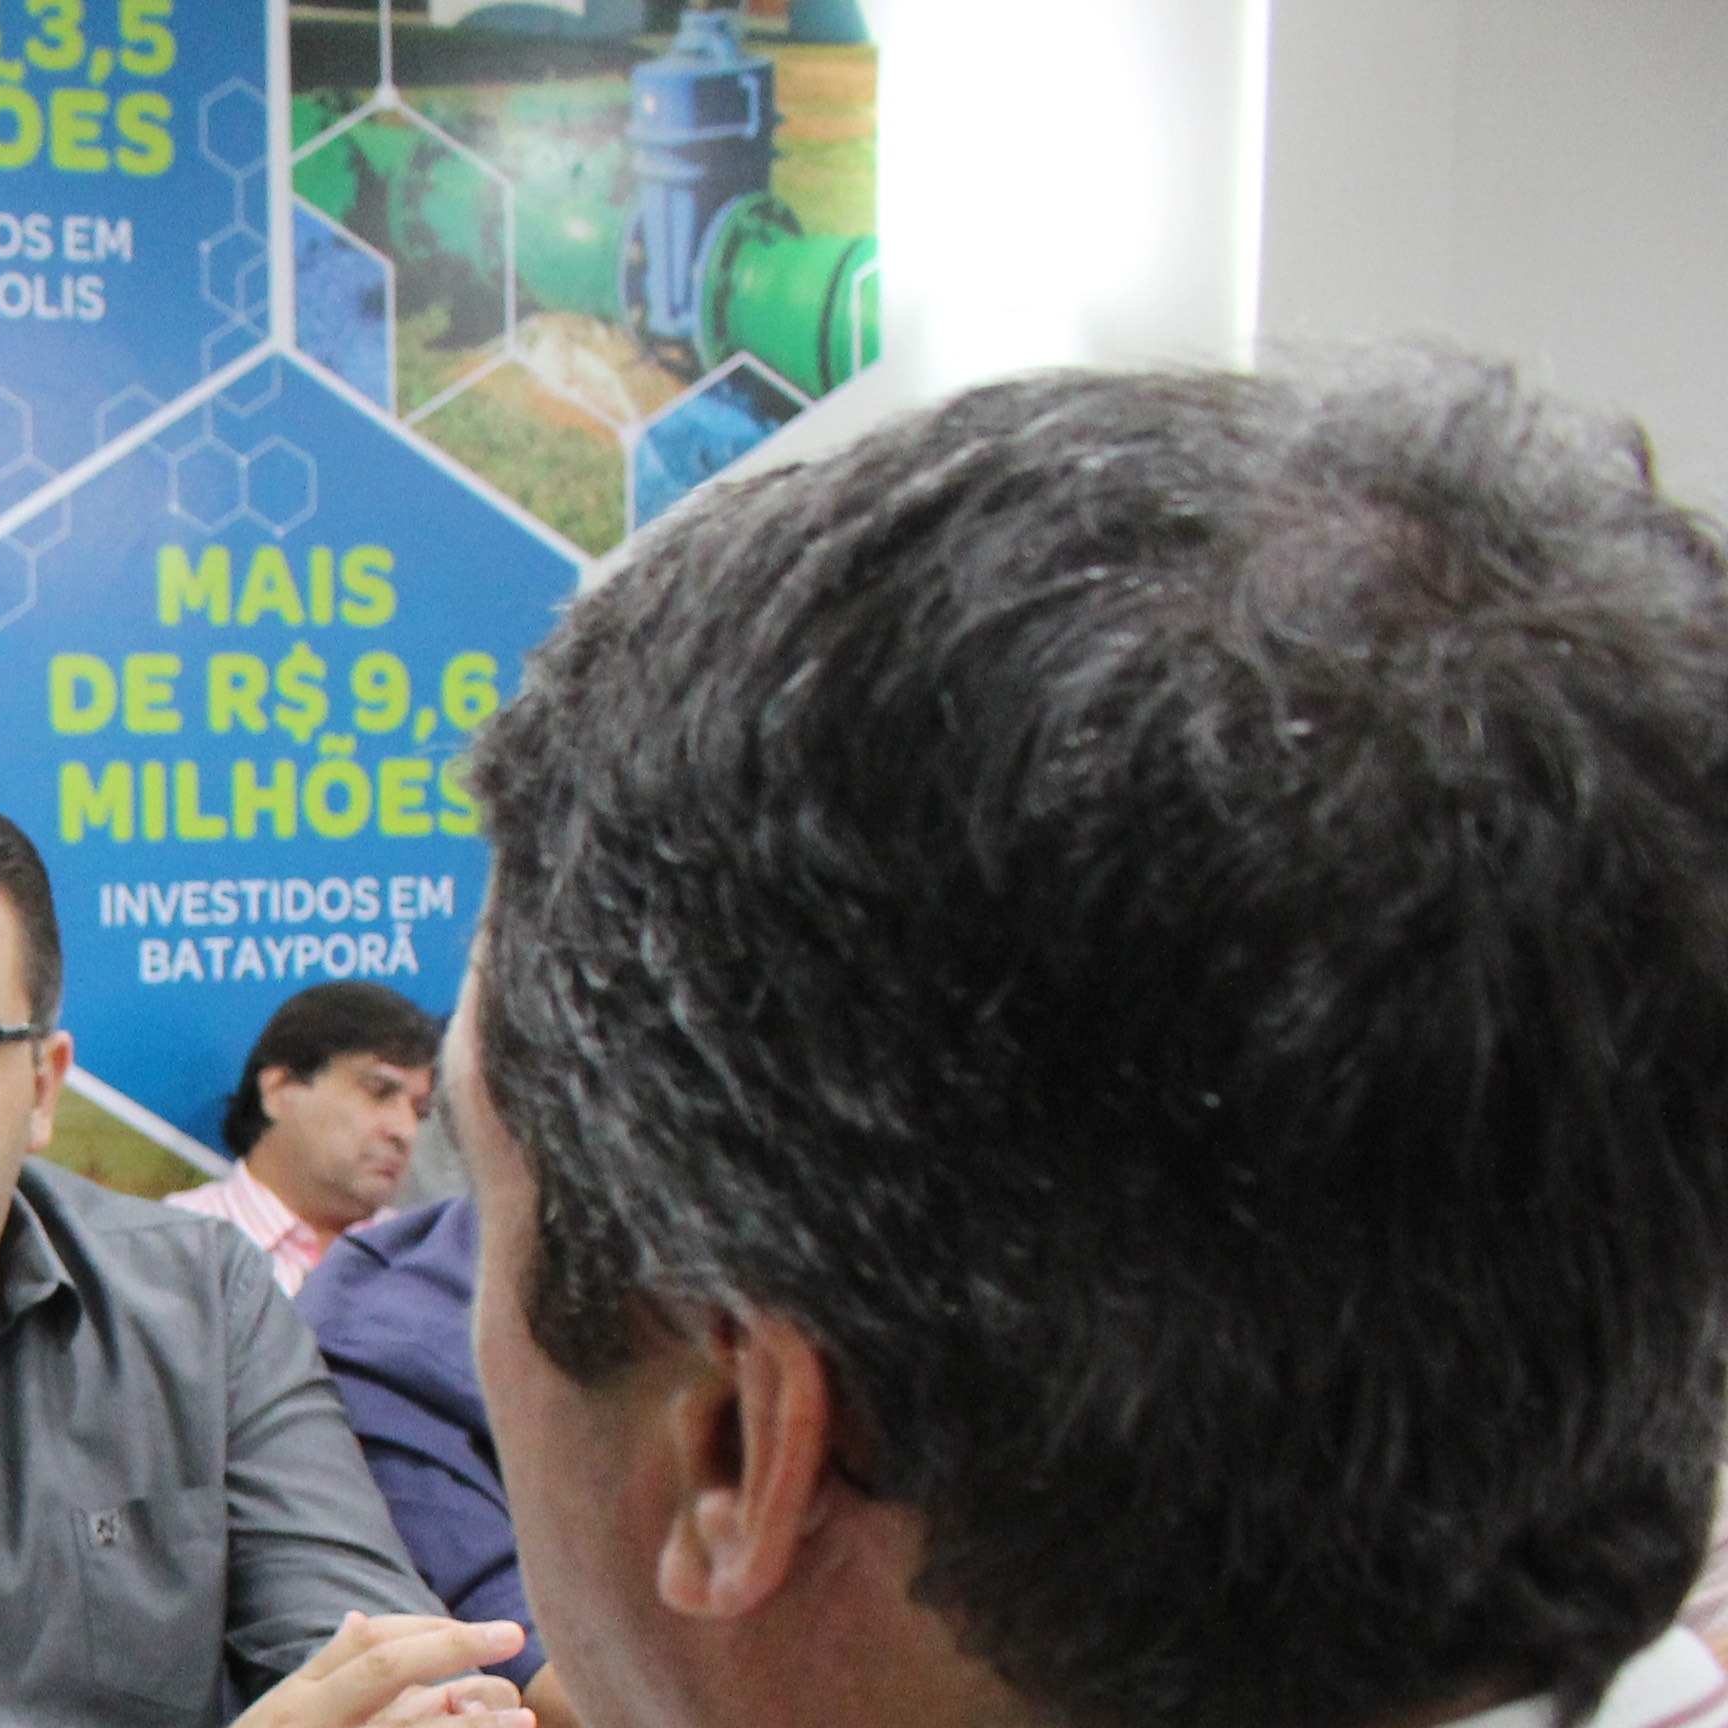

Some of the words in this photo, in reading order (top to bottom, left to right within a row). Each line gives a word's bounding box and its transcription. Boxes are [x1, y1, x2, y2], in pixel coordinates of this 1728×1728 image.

[25, 0, 176, 84] 3,5
[63, 216, 134, 262] EM
[157, 545, 397, 628] MAIS
[49, 653, 183, 735] DE
[207, 642, 329, 744] R$
[350, 651, 501, 743] 9,6
[58, 734, 490, 843] MILHÕES
[100, 875, 382, 927] INVESTIDOS
[389, 875, 455, 920] EM
[139, 922, 419, 984] BATAYPORÃ
